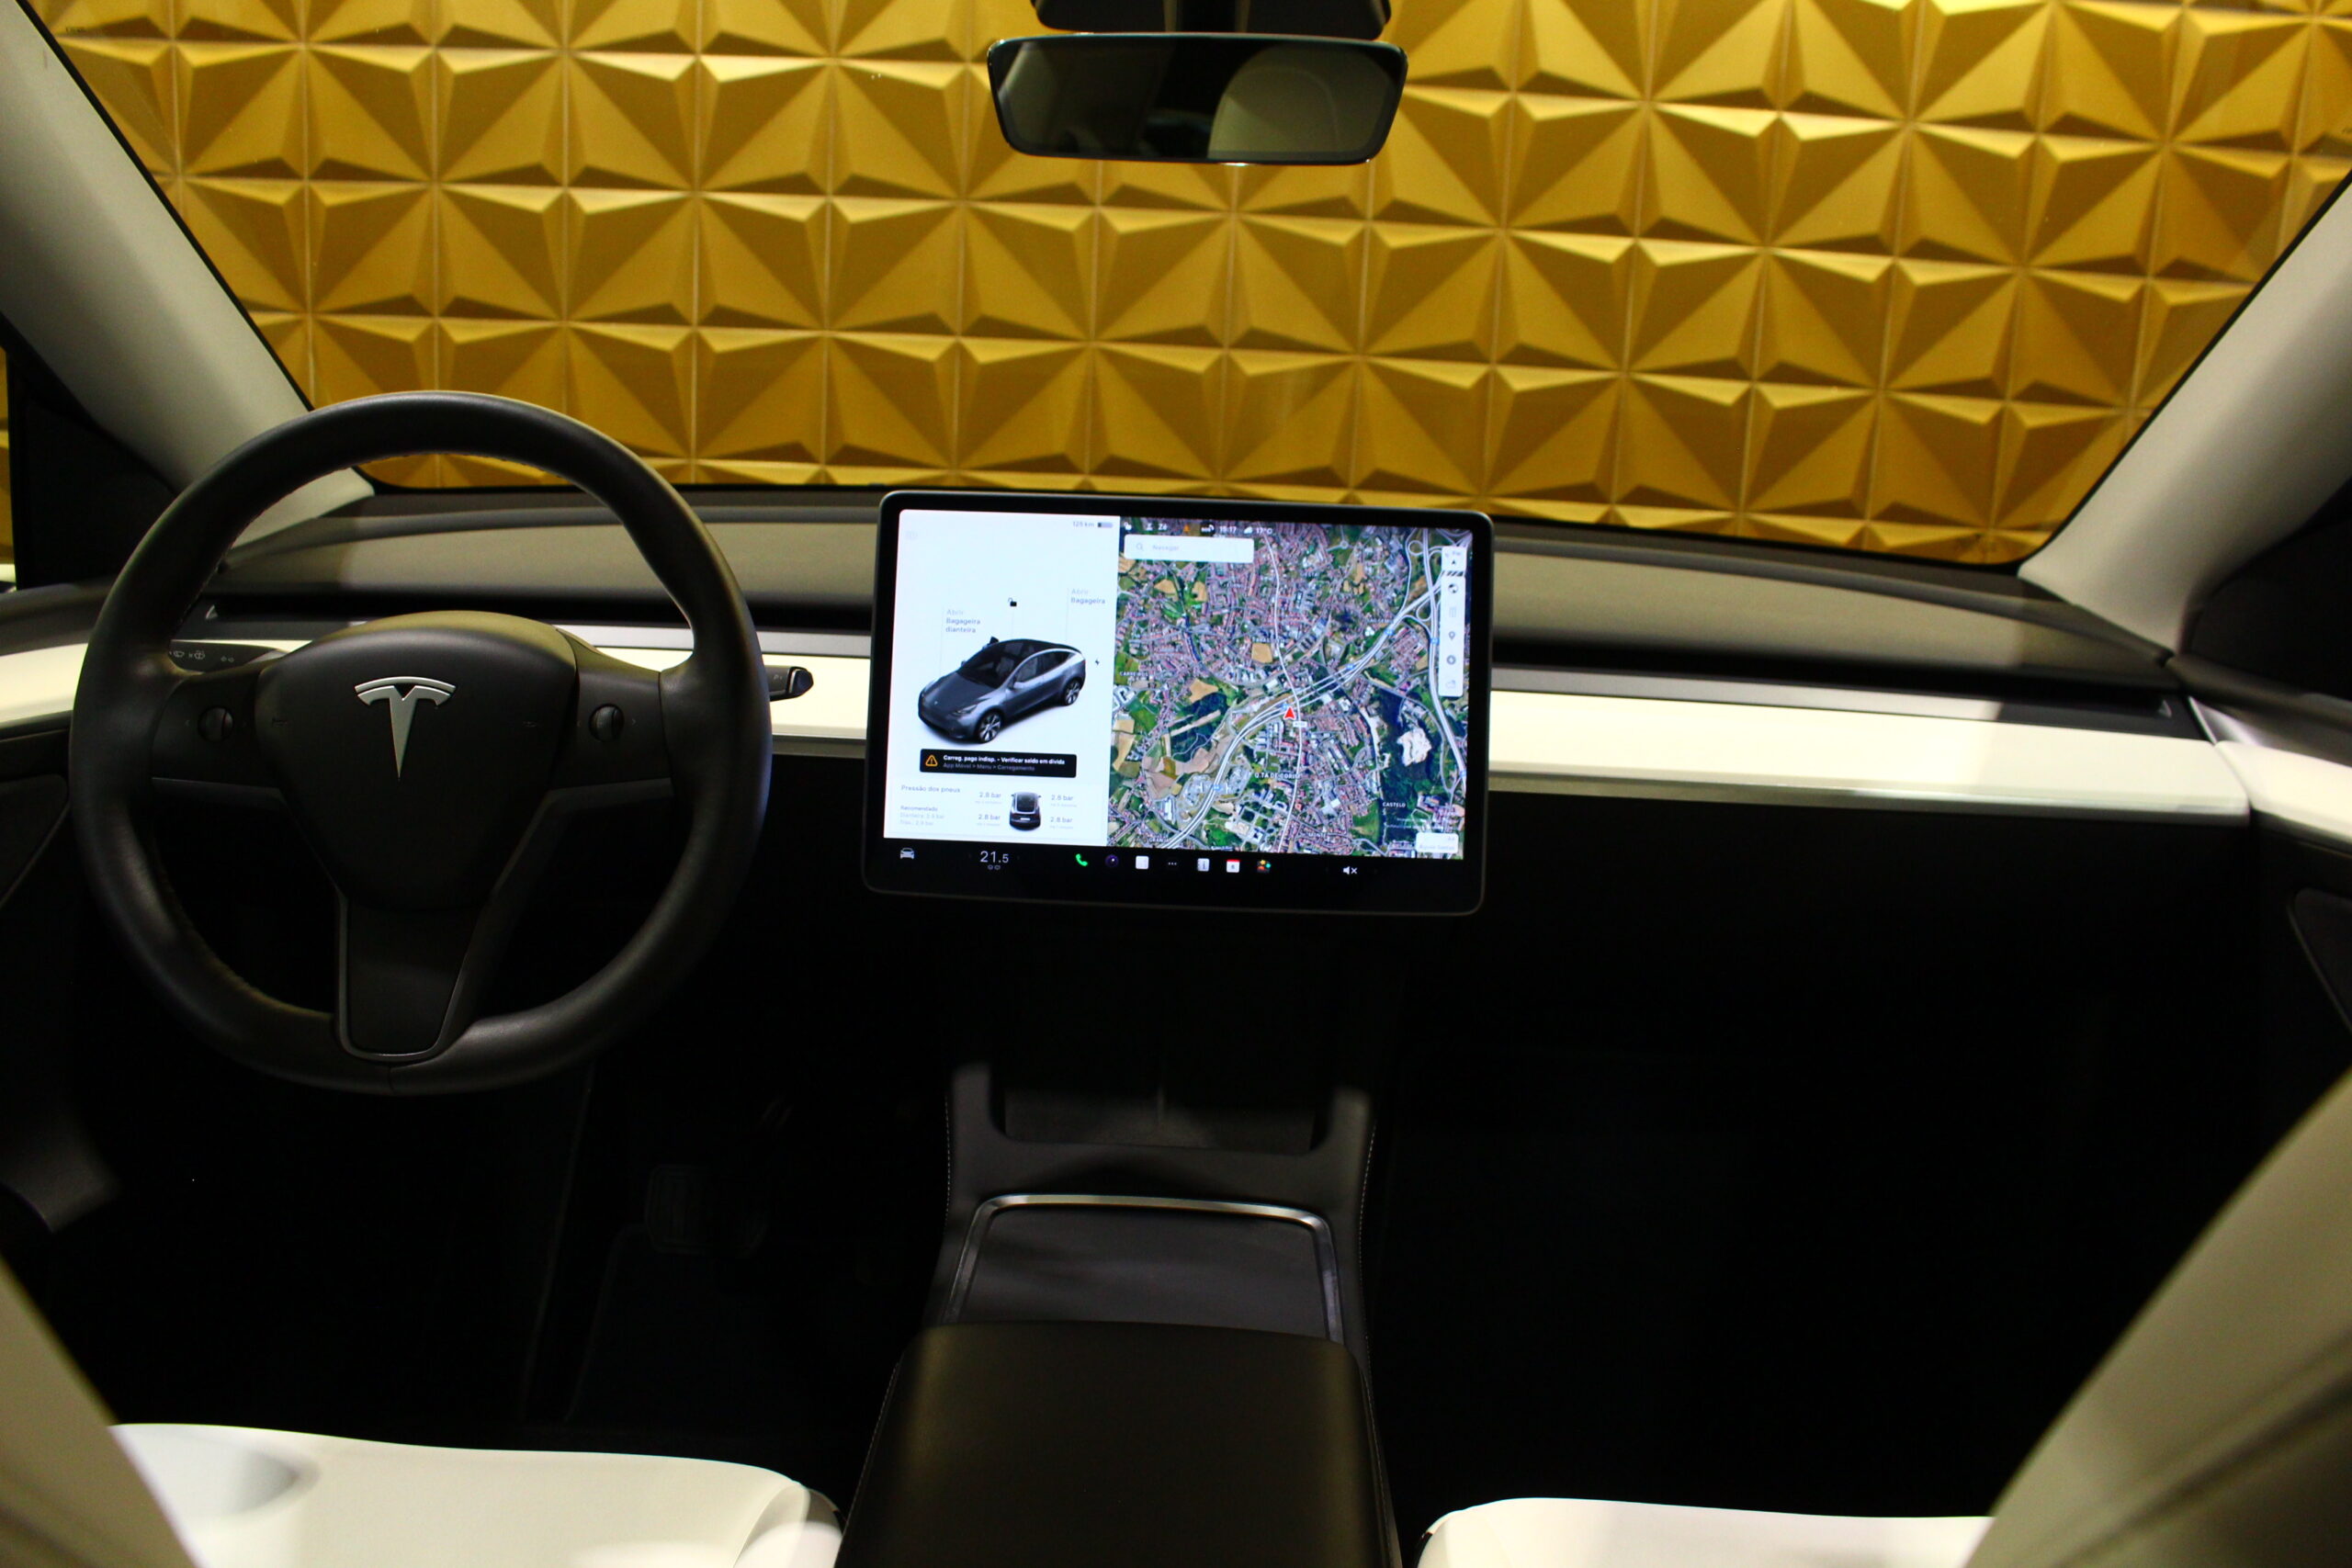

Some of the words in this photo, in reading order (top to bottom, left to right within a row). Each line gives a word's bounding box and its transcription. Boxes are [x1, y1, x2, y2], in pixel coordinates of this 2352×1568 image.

[1069, 596, 1106, 605] Bagageira
[945, 616, 981, 626] Bagageira
[945, 626, 977, 634] dianteira
[943, 754, 963, 762] Carreg.
[980, 851, 1009, 863] 21.5
